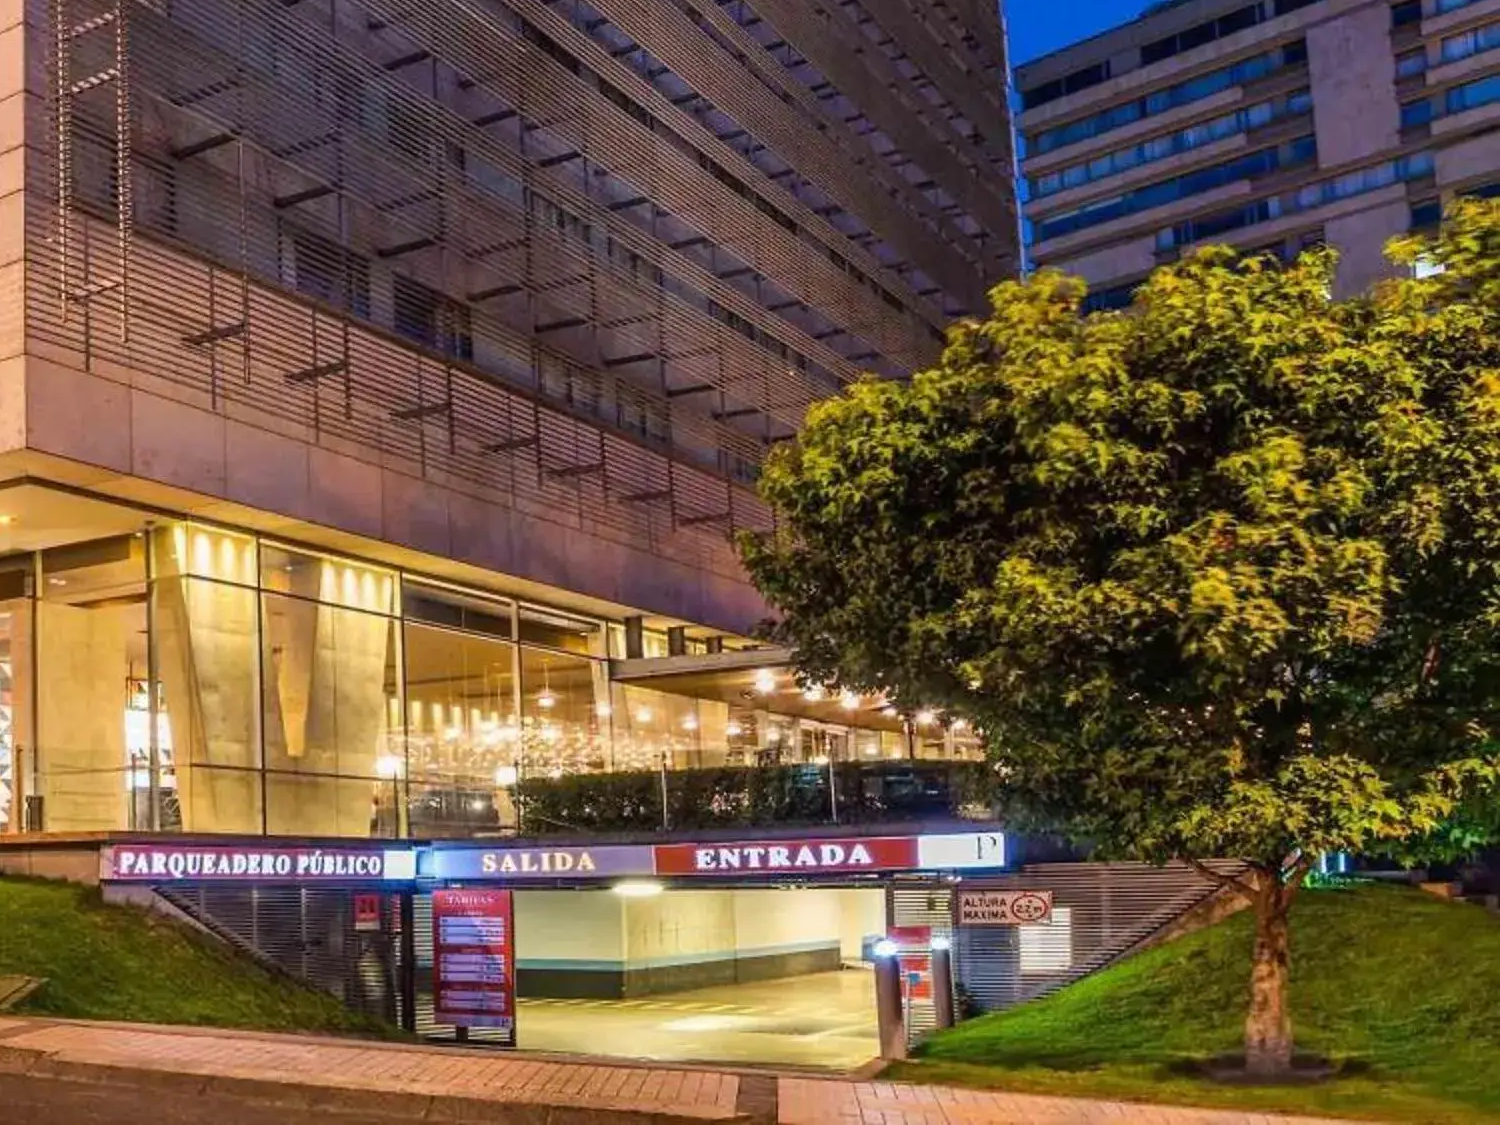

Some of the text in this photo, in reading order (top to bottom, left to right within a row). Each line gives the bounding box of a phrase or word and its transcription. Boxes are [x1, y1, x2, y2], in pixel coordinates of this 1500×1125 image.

[120, 850, 381, 878] PARQUEADERO PÚBLICO
[482, 852, 596, 872] SALIDA
[696, 843, 873, 869] ENTRADA
[963, 897, 1007, 907] ALTURA
